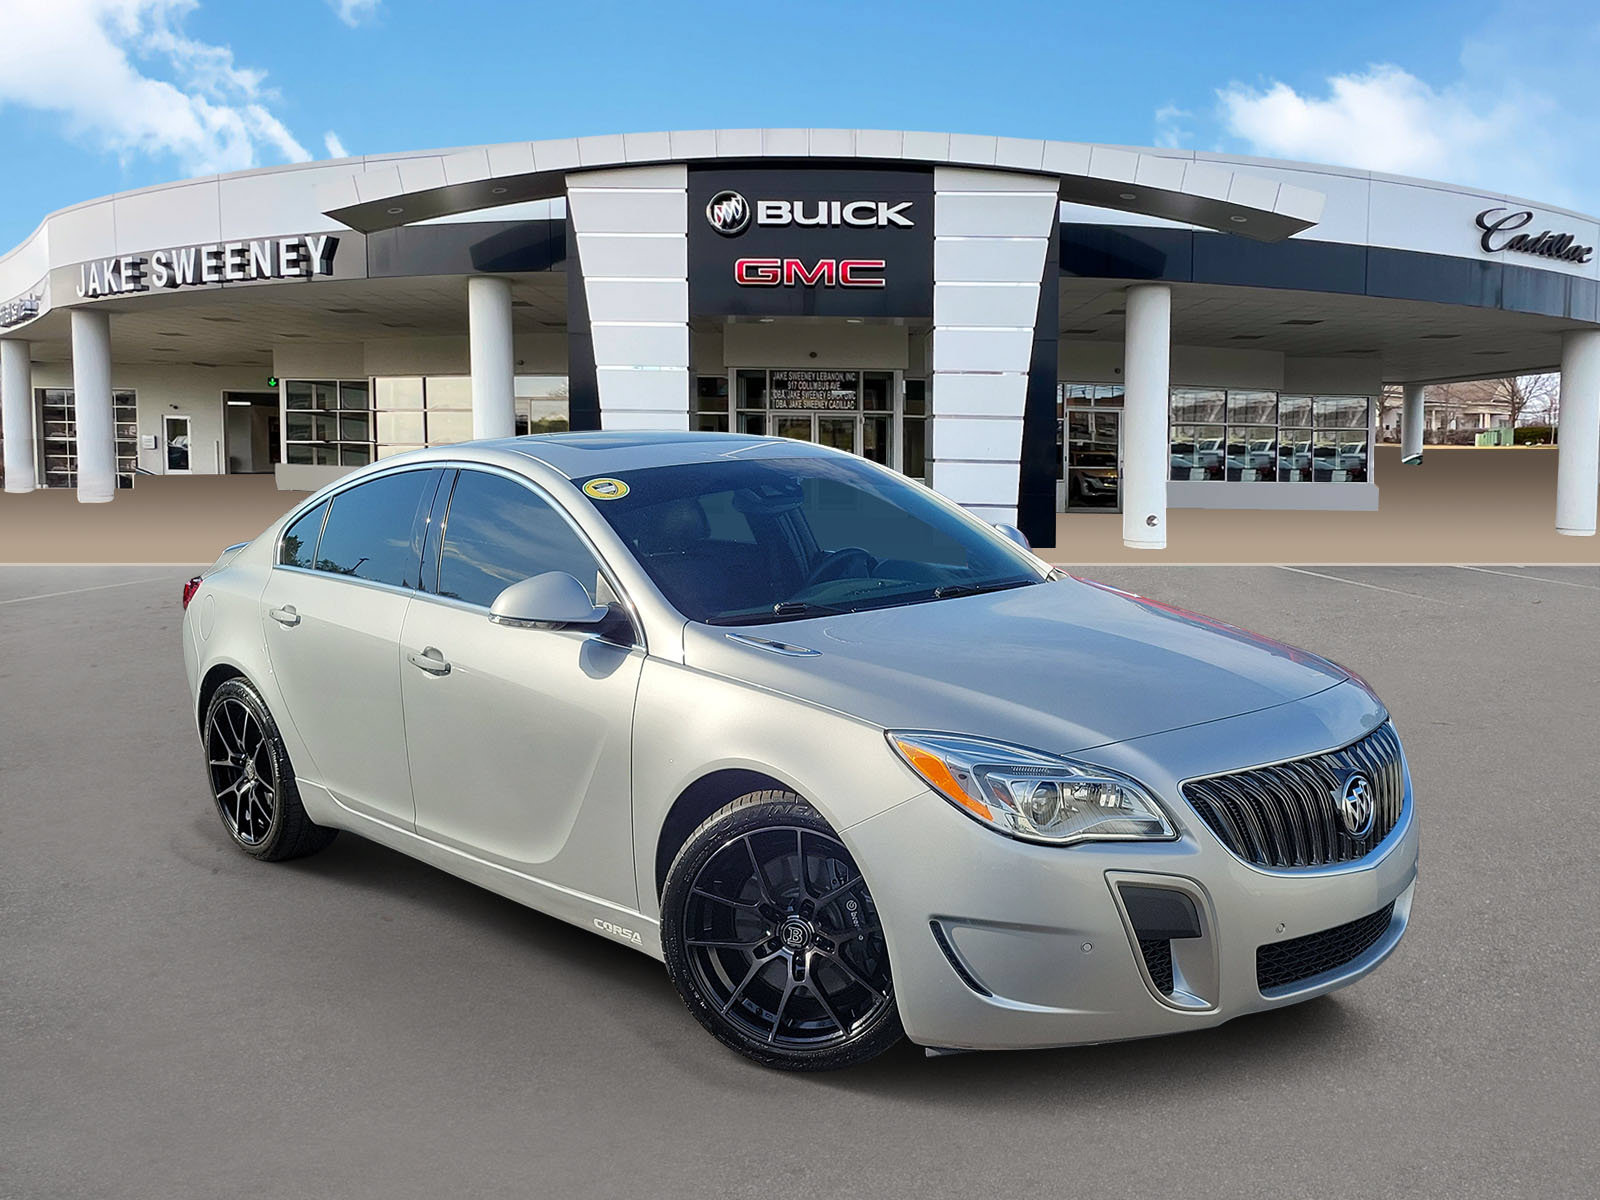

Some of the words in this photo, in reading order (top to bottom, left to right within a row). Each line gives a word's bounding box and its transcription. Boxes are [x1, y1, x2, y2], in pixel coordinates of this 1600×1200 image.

[757, 200, 915, 226] BUICK
[1475, 207, 1593, 263] Cadillac
[76, 255, 139, 298] JAKE
[152, 234, 331, 288] SWEENEY
[735, 258, 886, 287] GMC
[773, 371, 788, 381] JAKE
[788, 371, 816, 381] SWEENEY
[798, 381, 829, 390] COLUMBUS
[787, 390, 801, 399] JAKE
[801, 390, 826, 400] SWEENEY
[827, 391, 843, 399] BCK
[789, 400, 803, 409] JAKE
[803, 400, 828, 409] SWEENEY
[828, 400, 855, 409] CADILLAC
[593, 918, 643, 946] CORSA
